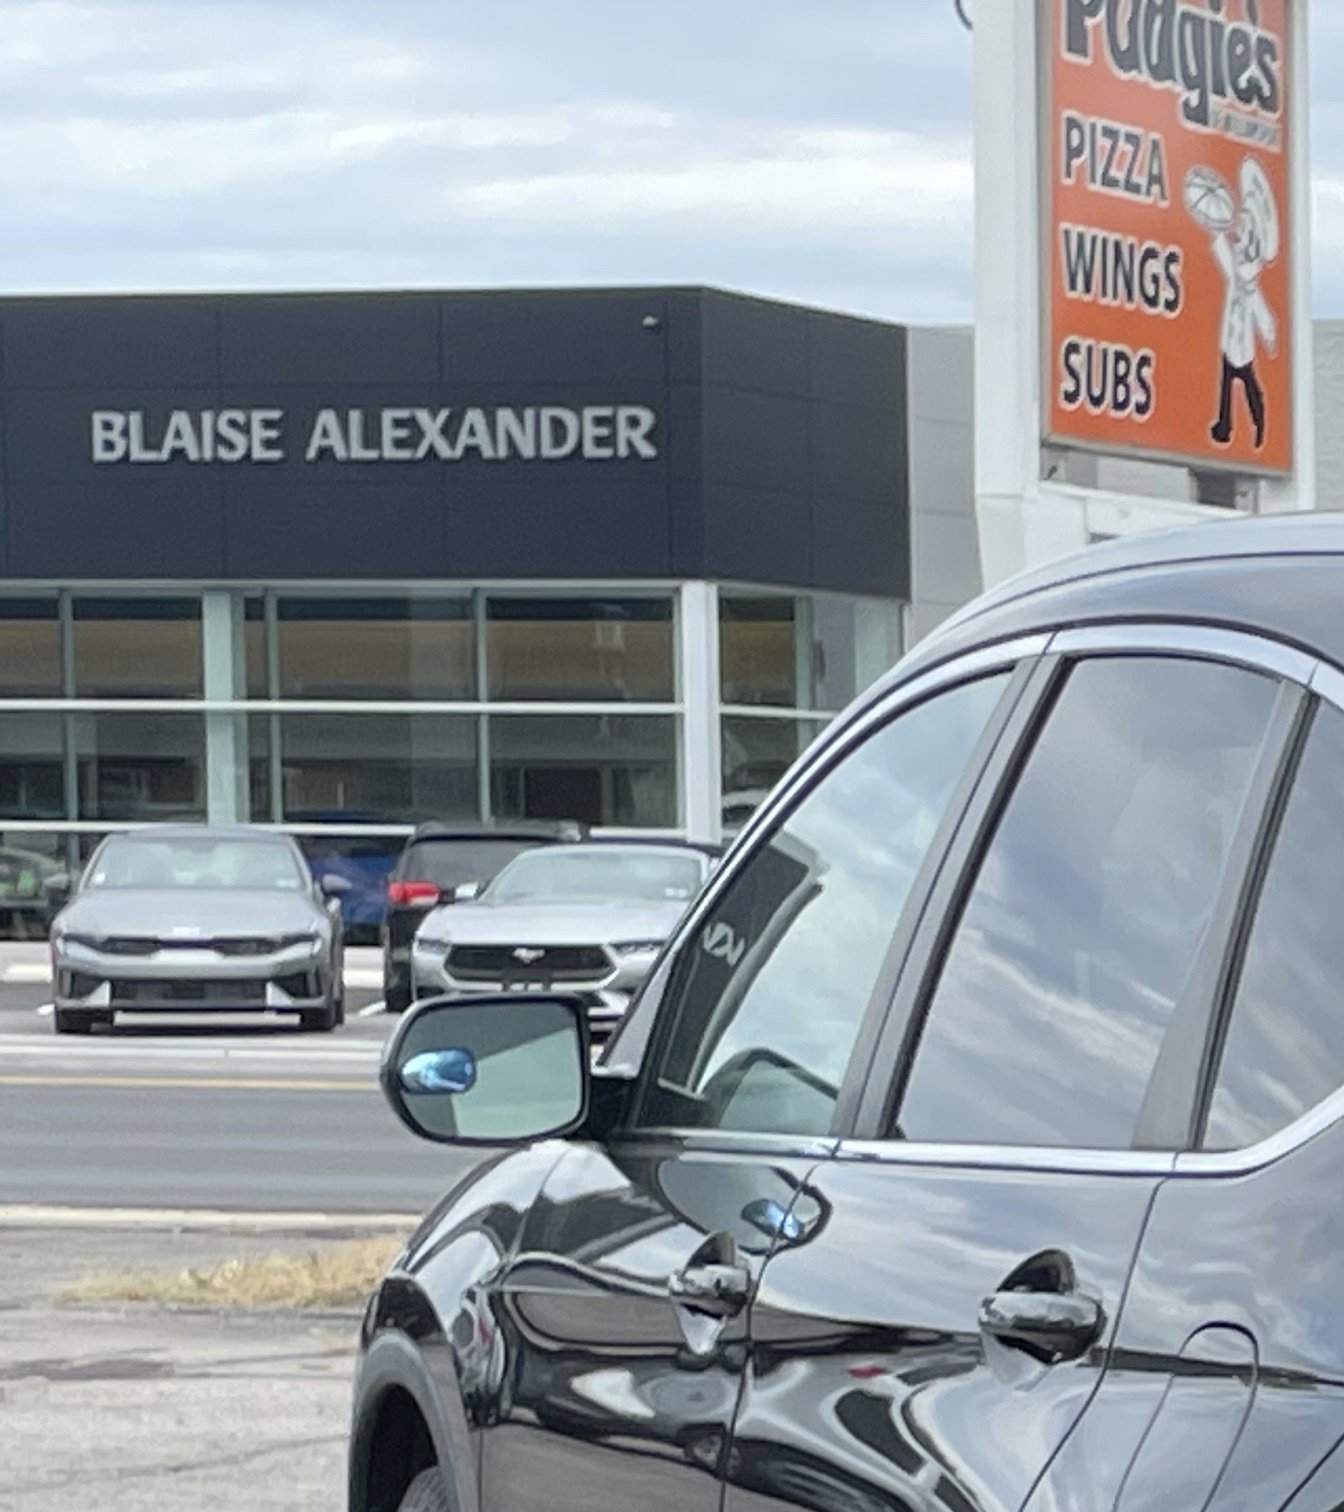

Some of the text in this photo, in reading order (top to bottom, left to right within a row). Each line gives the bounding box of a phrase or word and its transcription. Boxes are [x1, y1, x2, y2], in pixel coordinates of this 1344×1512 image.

[1064, 115, 1168, 202] PIZZA
[1063, 228, 1180, 312] WINGS
[1063, 342, 1152, 415] SUBS
[91, 406, 657, 462] BLAISE ALEXANDER
